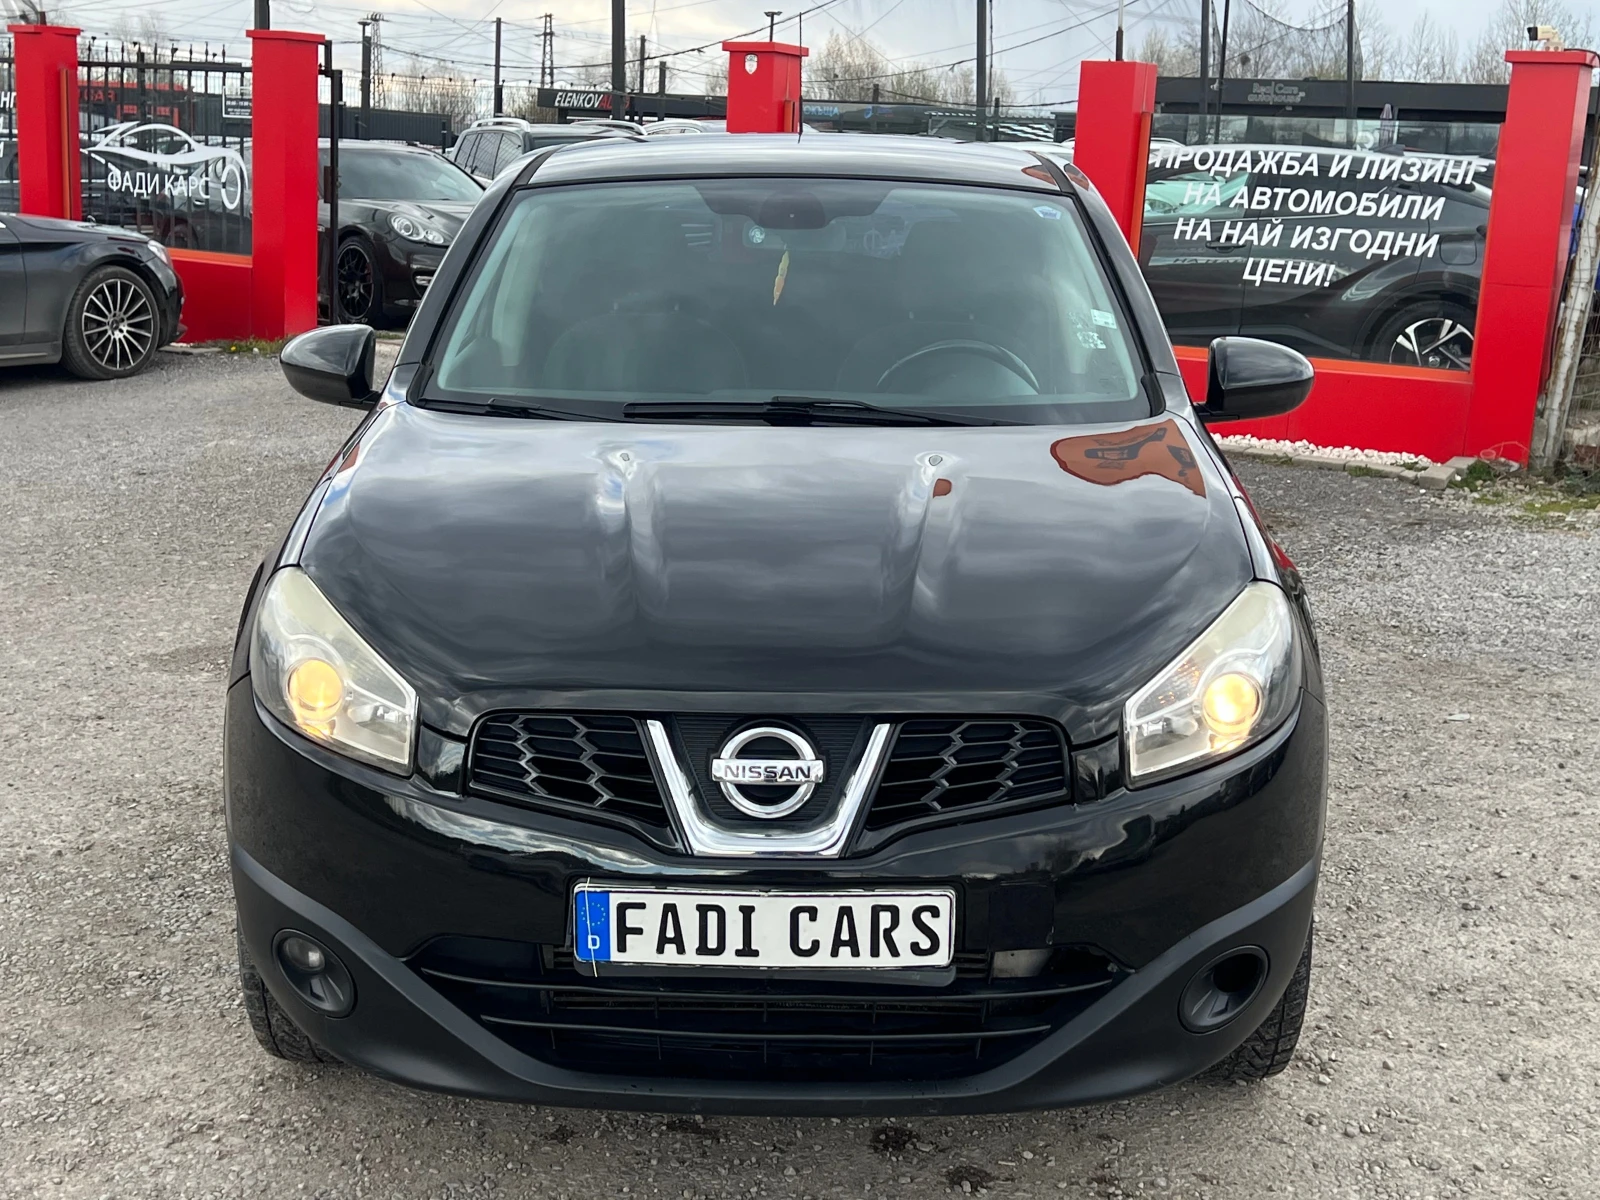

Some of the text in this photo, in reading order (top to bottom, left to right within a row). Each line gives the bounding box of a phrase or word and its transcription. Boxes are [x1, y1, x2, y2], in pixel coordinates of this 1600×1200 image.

[107, 170, 210, 199] ФАДИ КАРС
[1154, 147, 1489, 185] ПРОДАЖБА И ЛИЗИНГ
[1183, 182, 1446, 221] НА АВТОМОБИЛИ
[1173, 217, 1440, 261] НА НАЙ ИЗГОДНИ
[1243, 257, 1335, 287] ЦЕНИ!
[724, 763, 811, 780] NISSAN
[588, 901, 940, 959] D FADI CARS
